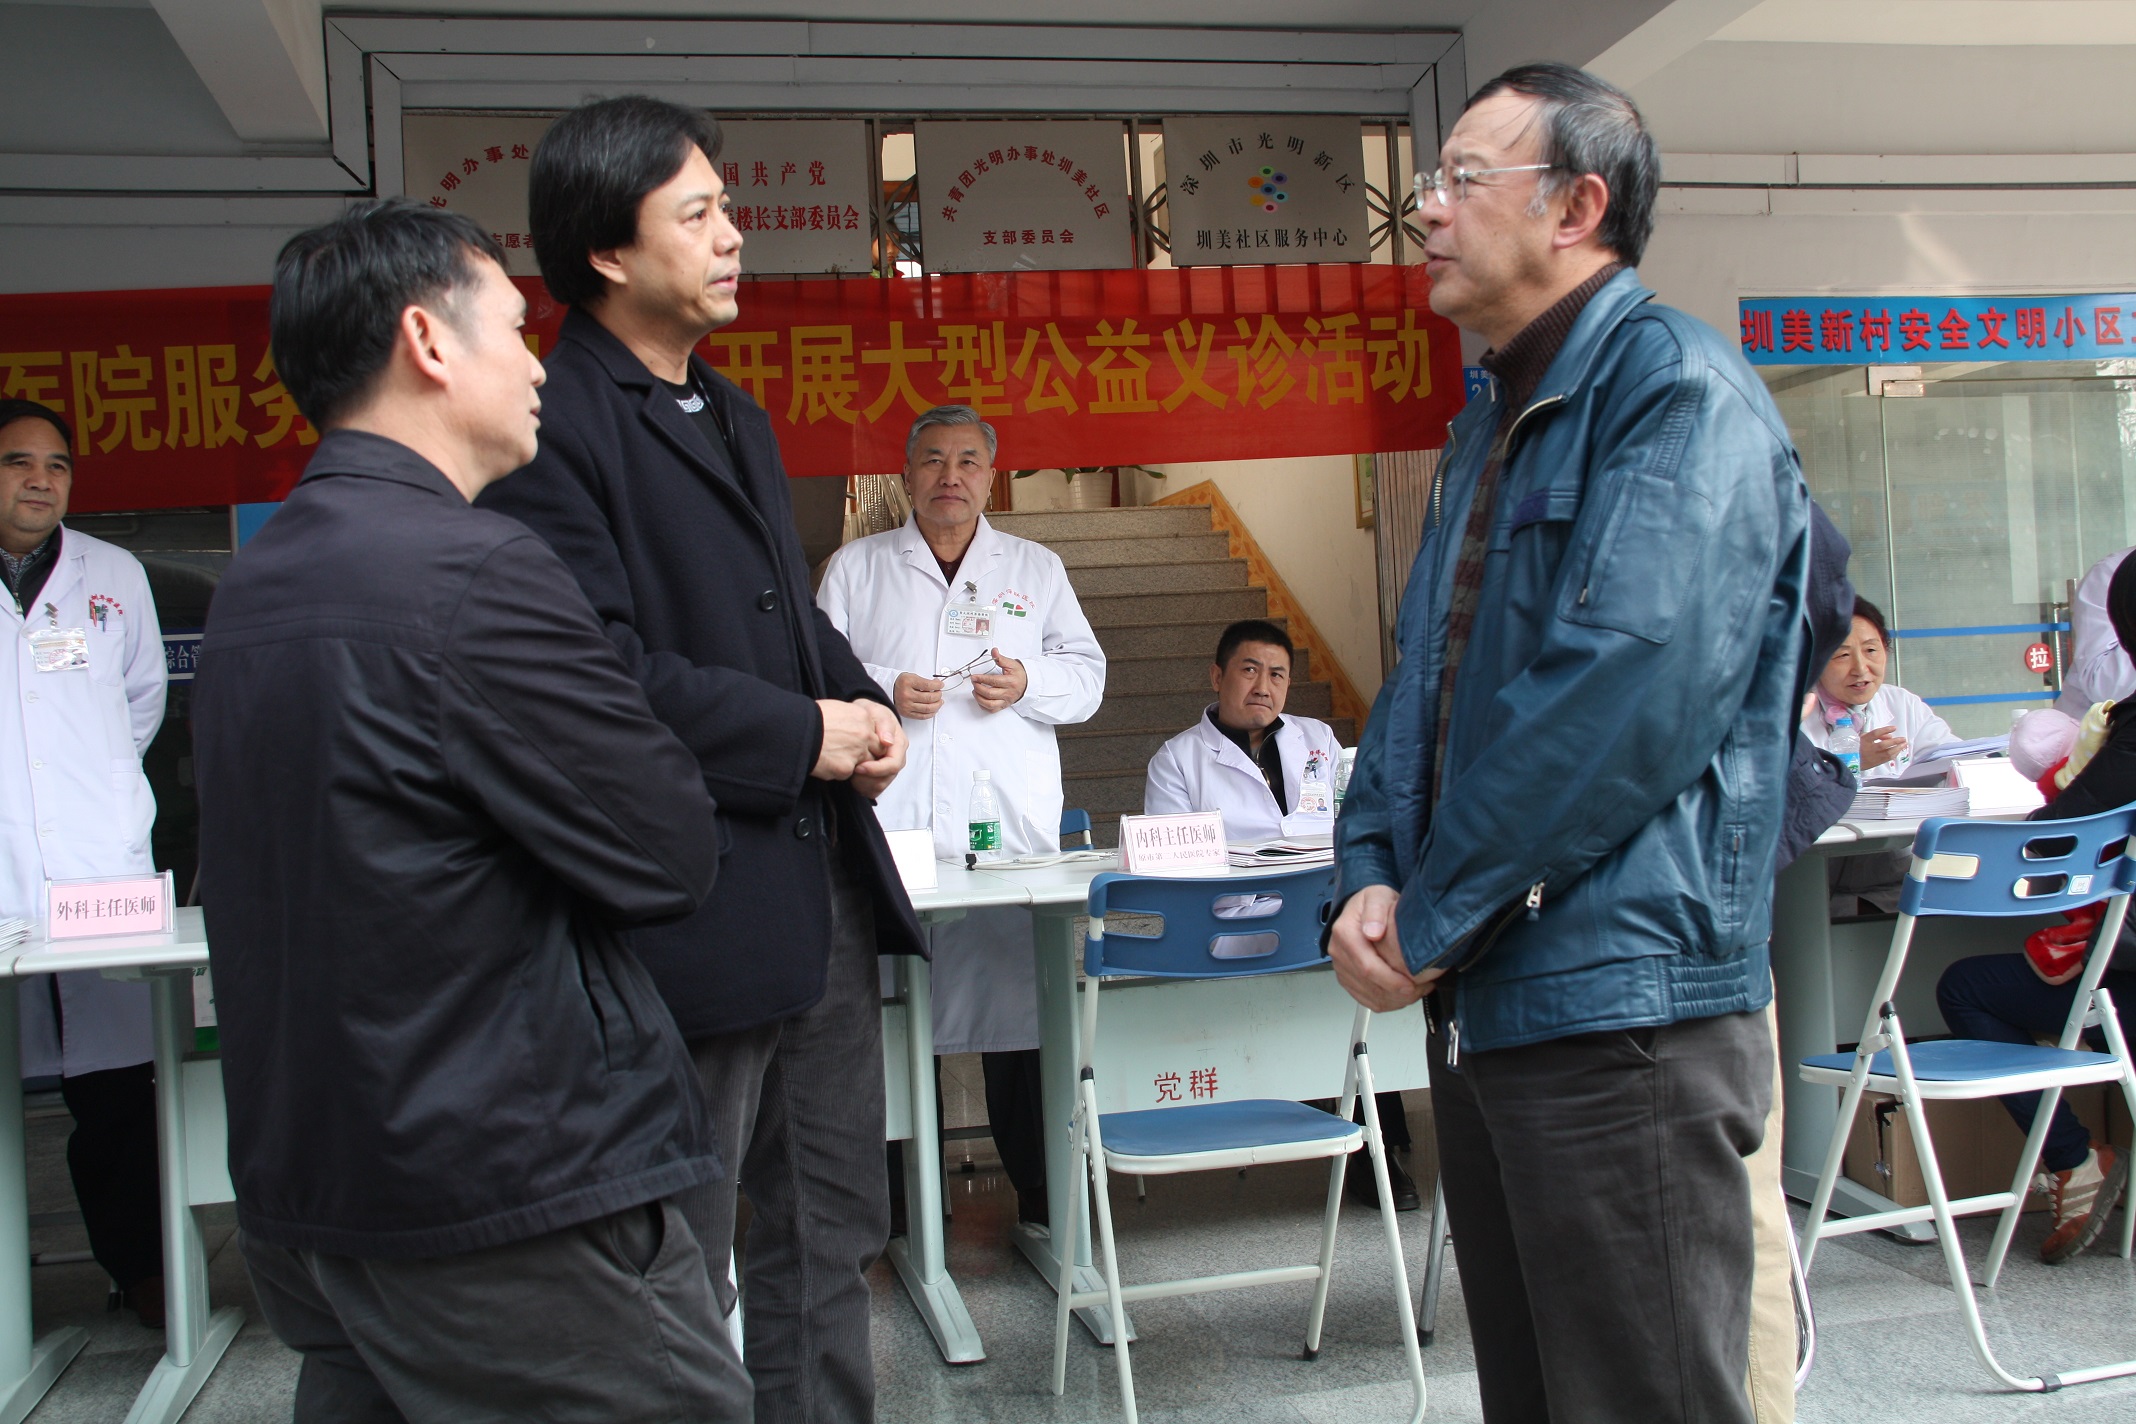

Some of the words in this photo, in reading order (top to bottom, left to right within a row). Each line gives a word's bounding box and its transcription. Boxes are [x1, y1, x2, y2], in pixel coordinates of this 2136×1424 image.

[1180, 132, 1355, 196] 深圳市光明新区
[942, 145, 1110, 222] 共青团光明办事处圳美社区
[983, 229, 1074, 245] 支部委员会
[1197, 227, 1348, 250] 圳美社区服务中心
[1740, 306, 2136, 352] 圳美新村安全文明小区
[710, 308, 1431, 425] 开展大型公益义诊活动
[2030, 648, 2049, 668] 拉
[1136, 824, 1216, 848] 内科主任医师
[57, 896, 155, 920] 外科主任医师
[1154, 1067, 1218, 1103] 党群
